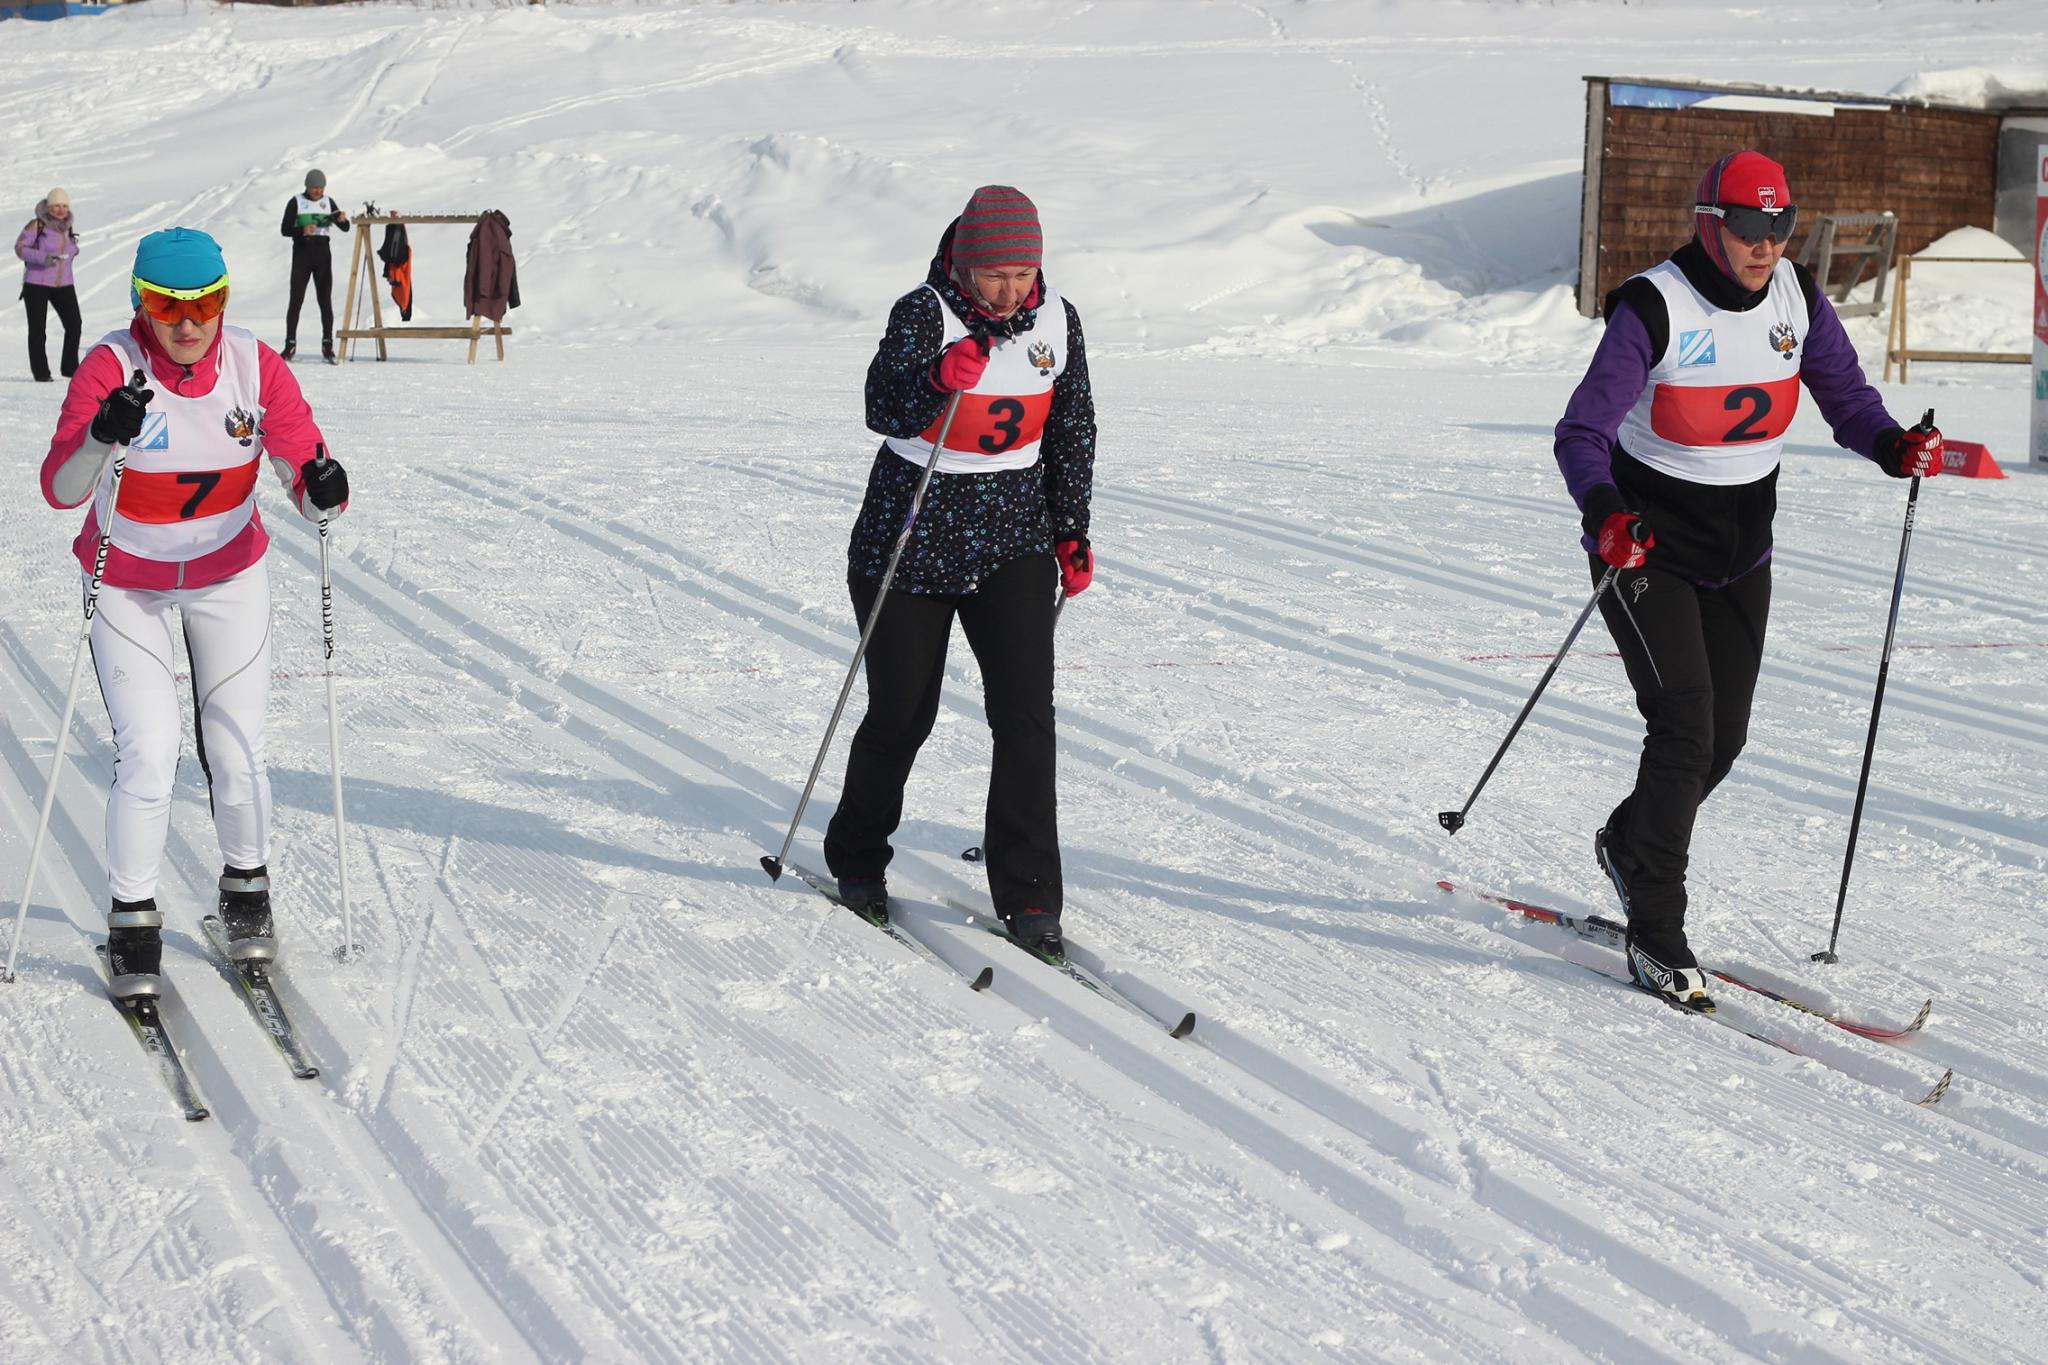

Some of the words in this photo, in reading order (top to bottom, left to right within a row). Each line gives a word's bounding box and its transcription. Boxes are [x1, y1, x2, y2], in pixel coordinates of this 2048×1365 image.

[978, 397, 1026, 455] 3
[1721, 387, 1773, 442] 2
[177, 472, 221, 519] 7
